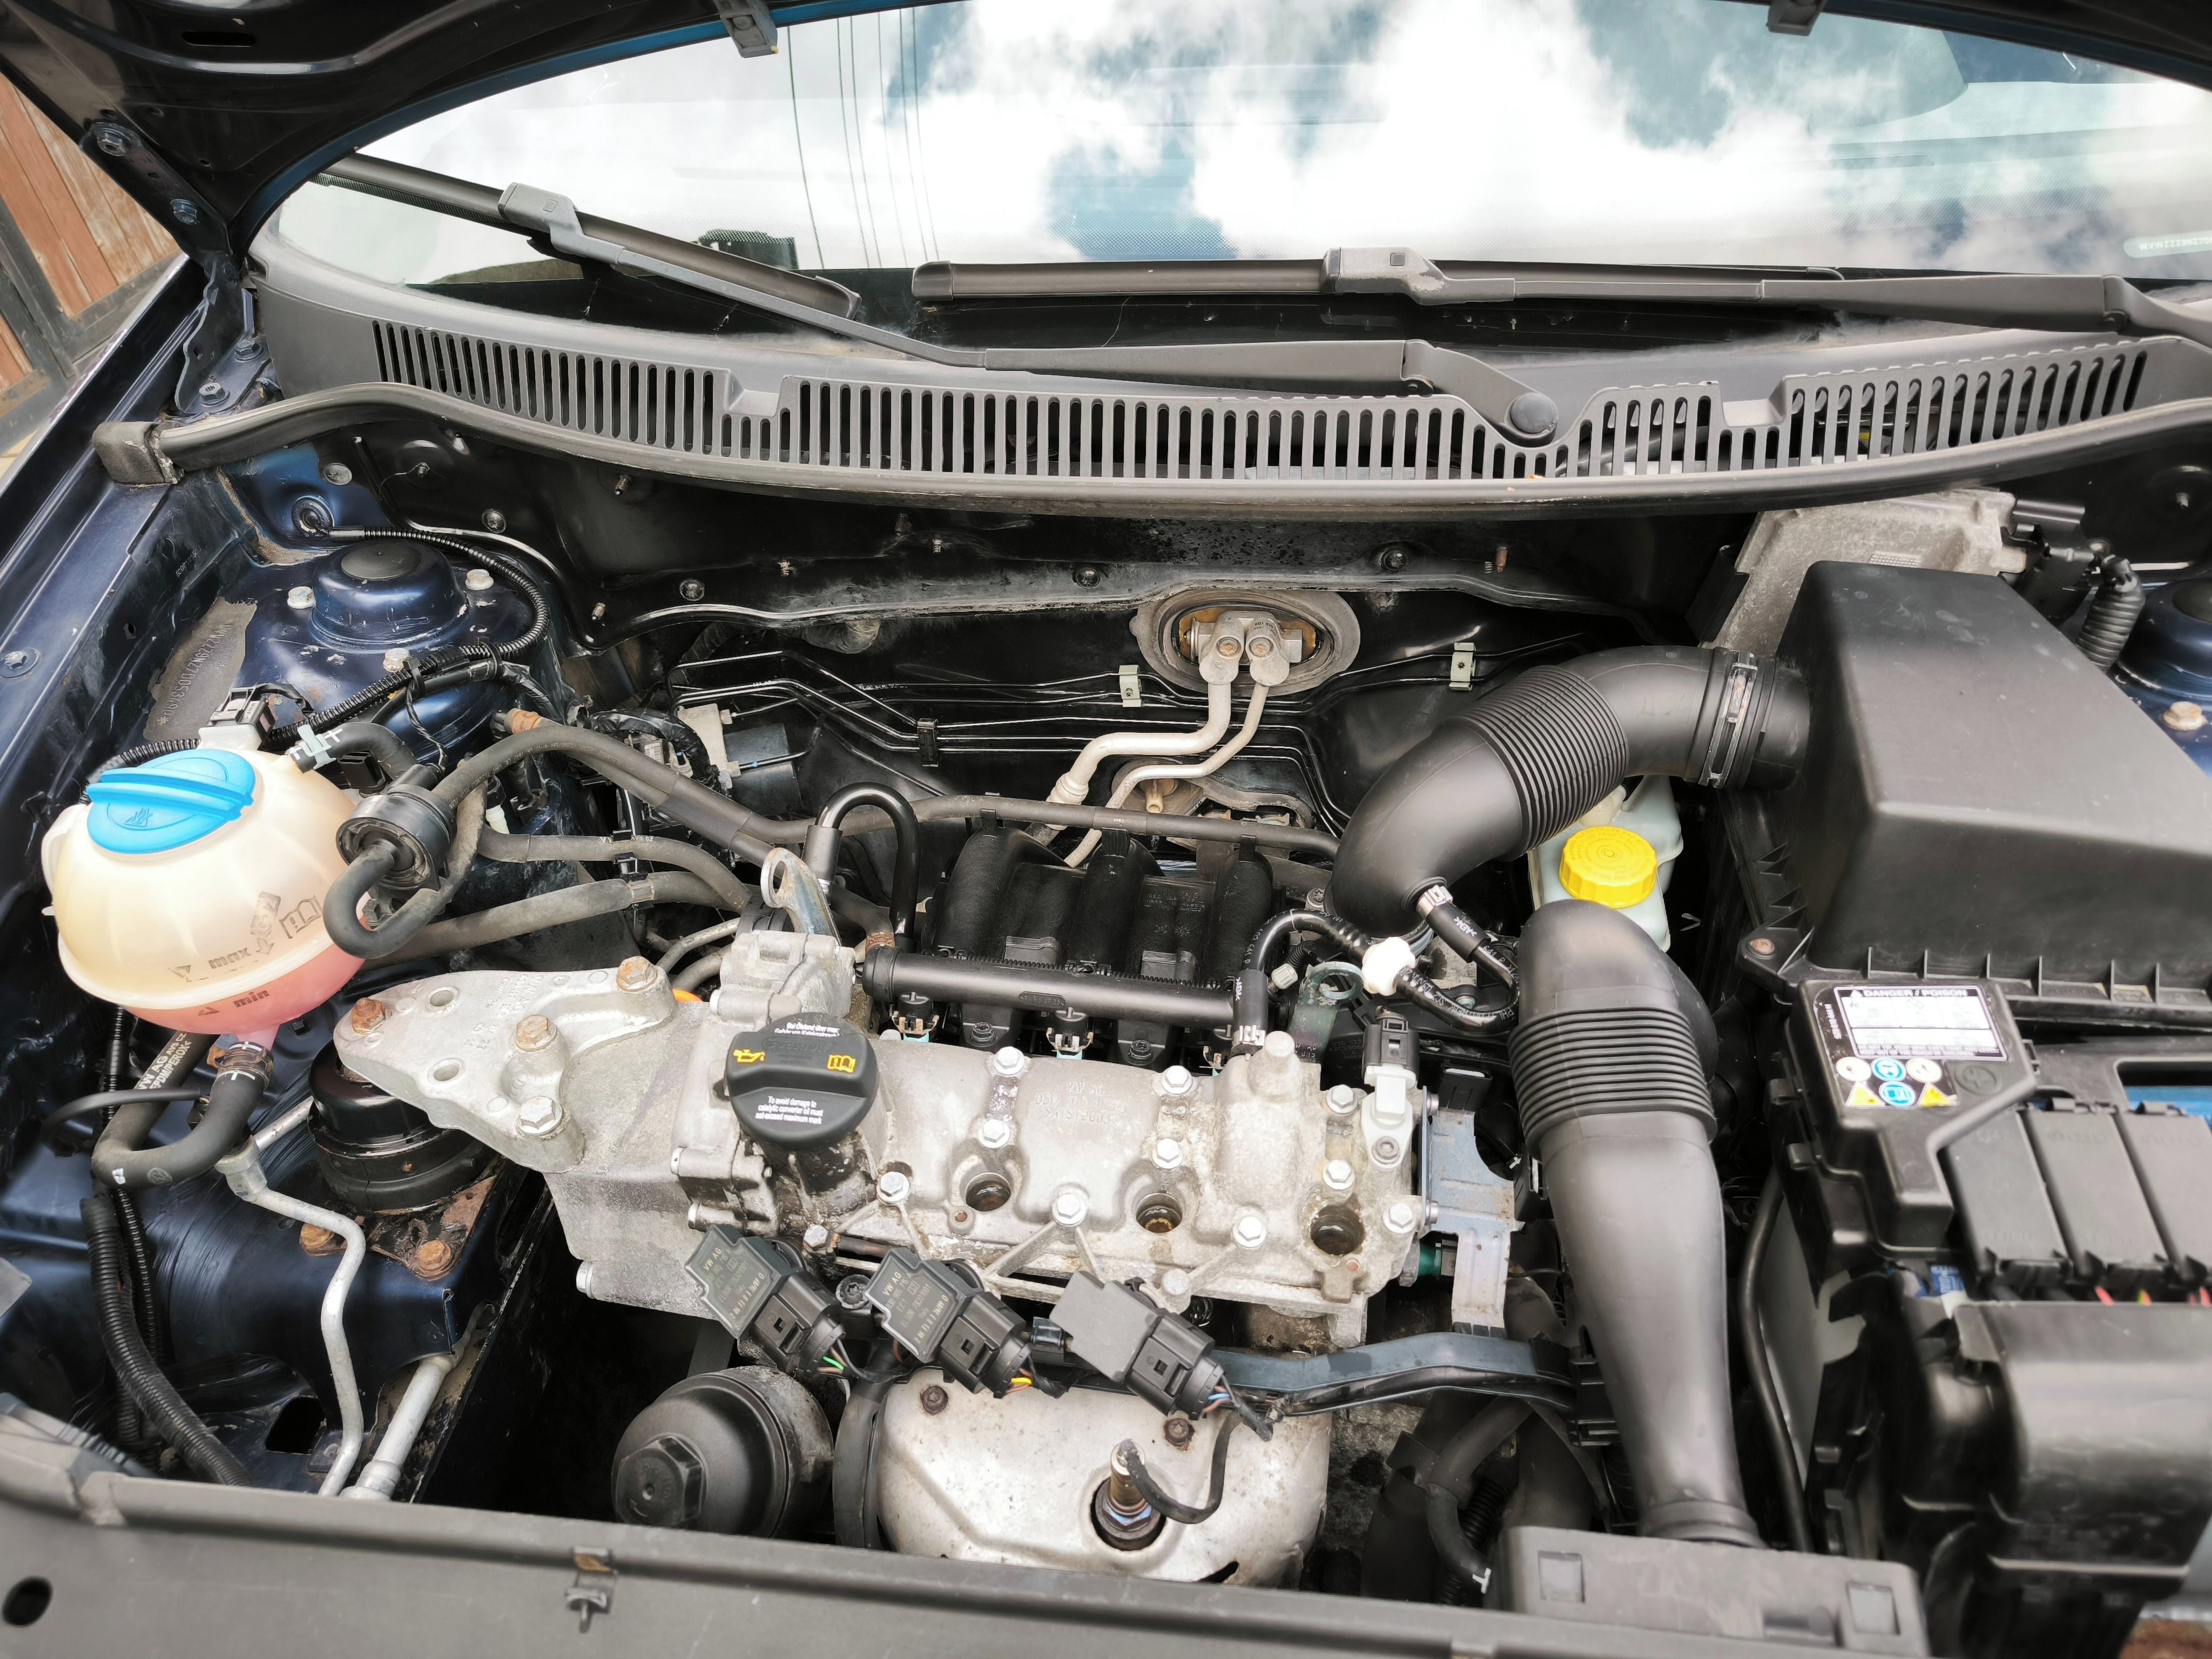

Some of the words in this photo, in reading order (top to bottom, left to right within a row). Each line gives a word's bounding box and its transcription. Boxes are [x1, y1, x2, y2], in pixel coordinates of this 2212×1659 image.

[208, 947, 252, 969] max
[233, 990, 269, 1007] min
[152, 1055, 168, 1072] AG
[176, 1033, 187, 1042] CZ
[768, 1096, 775, 1104] To
[703, 1259, 714, 1271] VW
[710, 1247, 721, 1259] AG
[882, 1283, 894, 1296] VW
[890, 1271, 902, 1283] AG
